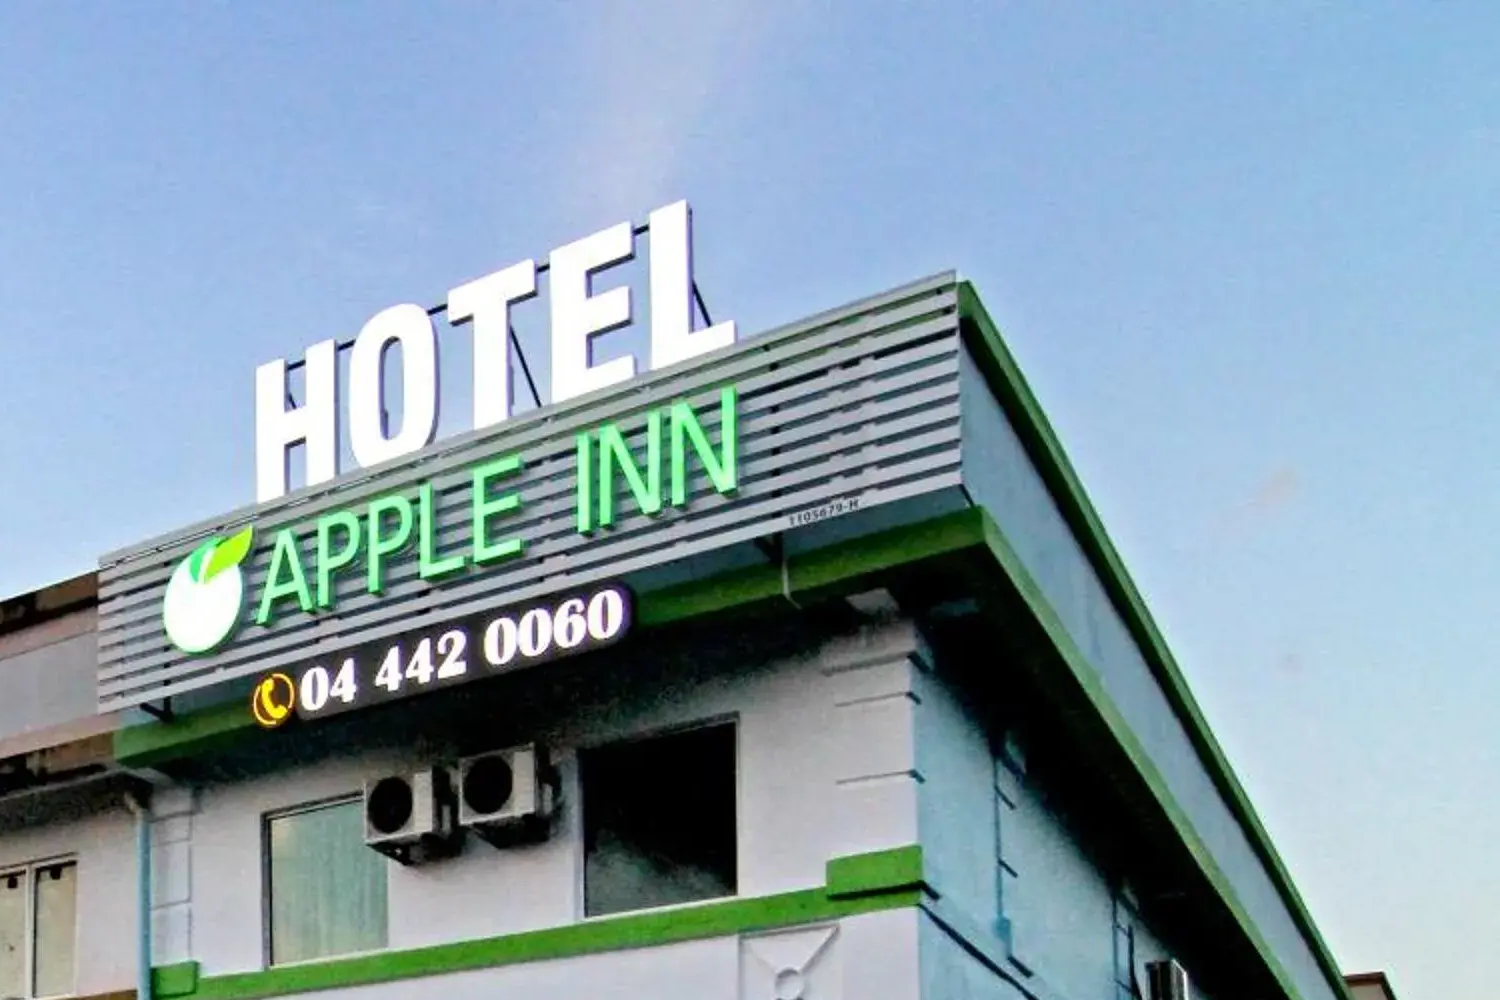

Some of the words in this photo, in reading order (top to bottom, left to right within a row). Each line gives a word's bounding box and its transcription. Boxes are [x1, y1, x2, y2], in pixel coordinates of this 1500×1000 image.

[256, 199, 737, 503] HOTEL
[255, 453, 526, 627] APPLE
[576, 387, 739, 536] INN
[299, 658, 358, 711] 04
[374, 629, 468, 692] 442
[483, 589, 625, 667] 0060
